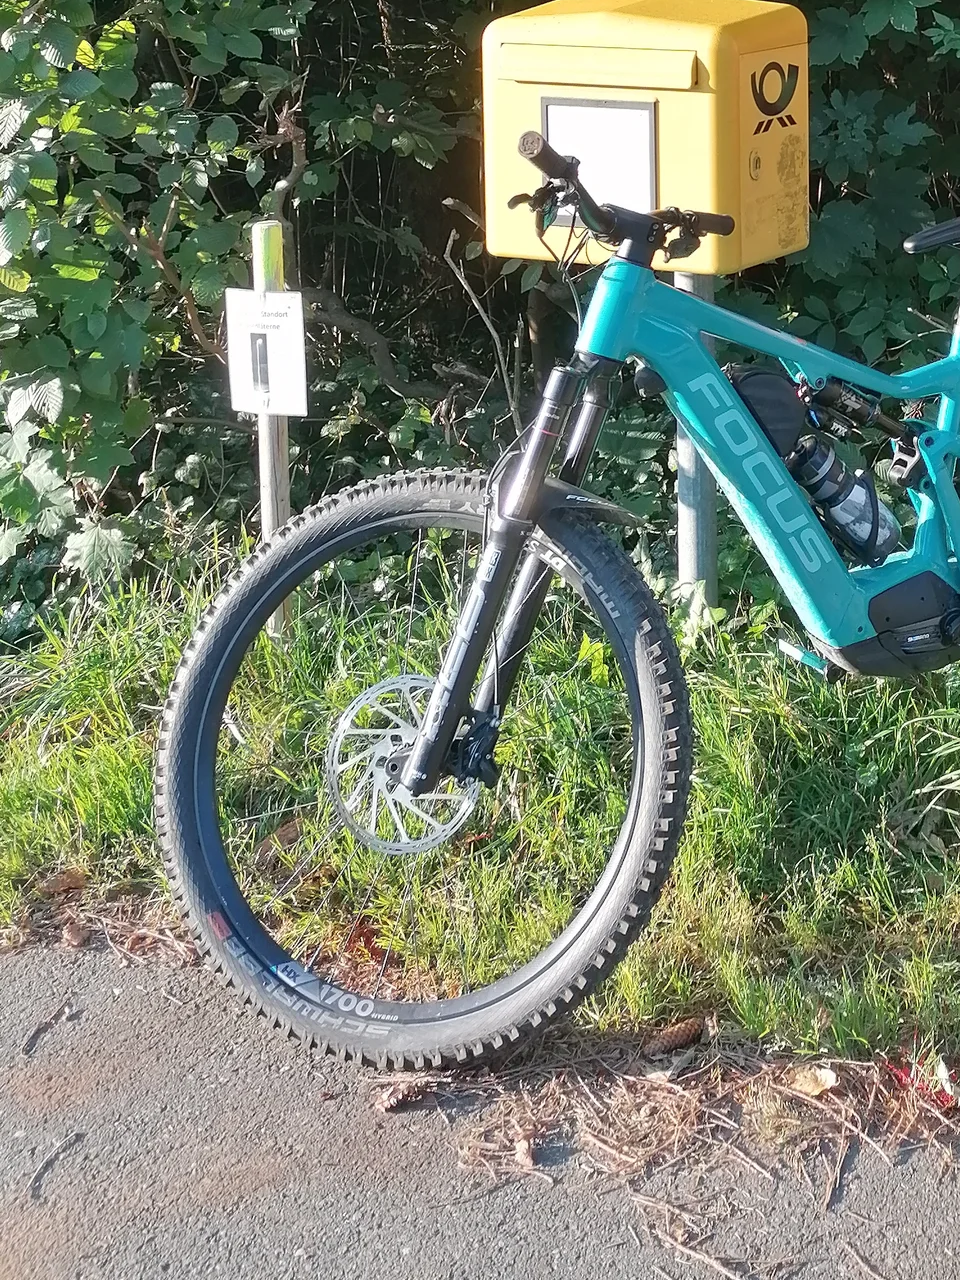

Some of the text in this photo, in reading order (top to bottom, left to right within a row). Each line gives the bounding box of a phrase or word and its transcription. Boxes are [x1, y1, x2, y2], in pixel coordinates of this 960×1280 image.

[687, 372, 832, 573] FOCUS
[540, 549, 567, 572] DT
[281, 965, 301, 983] HX
[320, 983, 375, 1017] 1700
